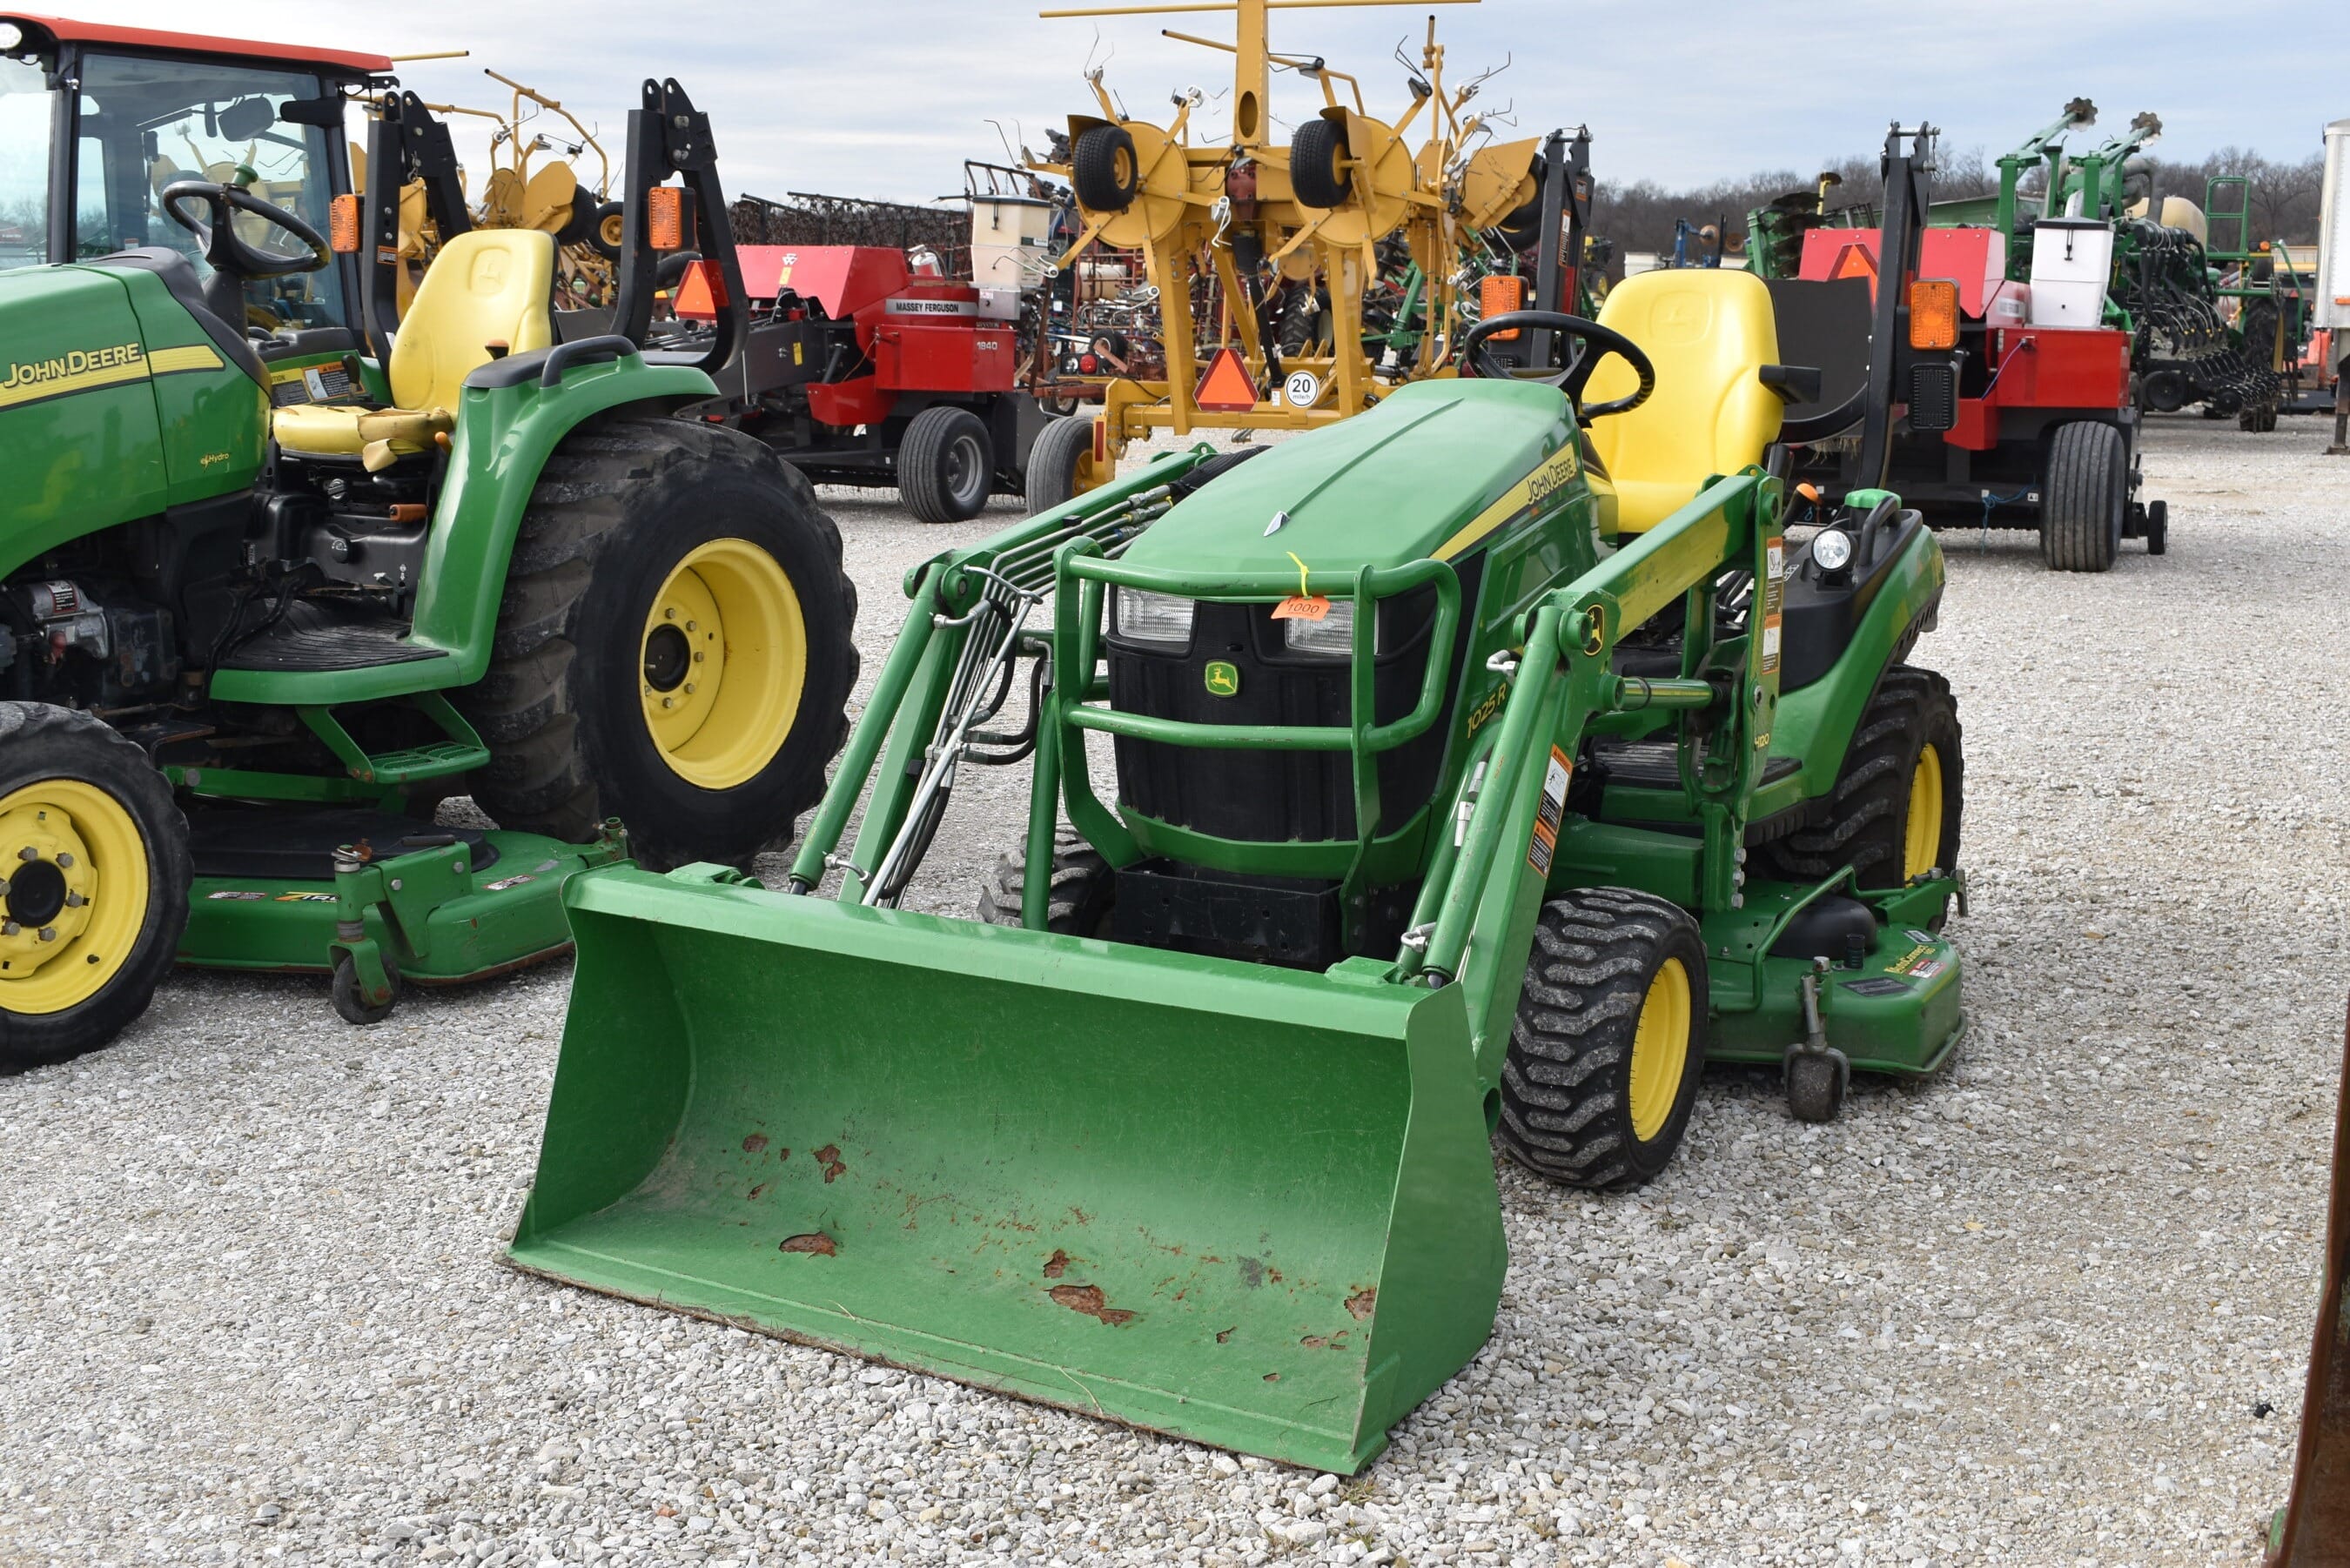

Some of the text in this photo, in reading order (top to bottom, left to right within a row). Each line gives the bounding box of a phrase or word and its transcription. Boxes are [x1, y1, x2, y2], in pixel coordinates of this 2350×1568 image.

[896, 302, 959, 312] MASSEY FERGUSON
[3, 343, 142, 388] JOHN DEERE
[1292, 379, 1311, 392] 20
[1527, 458, 1574, 502] JOHN DEERE
[1288, 603, 1319, 613] 1000
